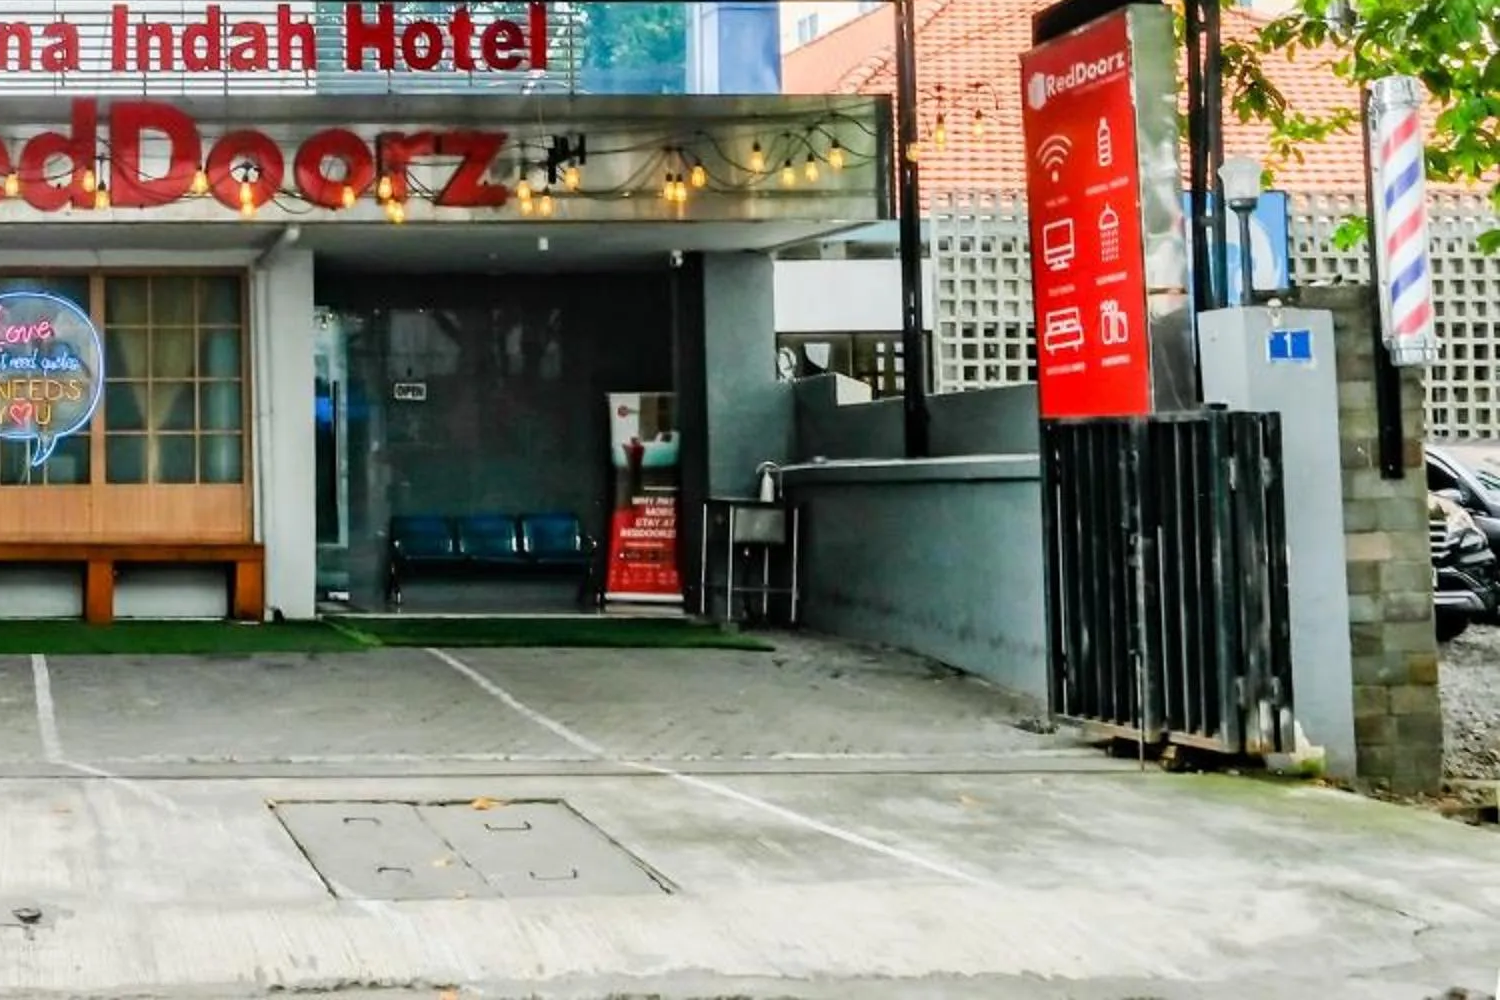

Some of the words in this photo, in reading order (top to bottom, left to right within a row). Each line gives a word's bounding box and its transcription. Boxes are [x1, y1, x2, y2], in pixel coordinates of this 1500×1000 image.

[111, 3, 316, 72] Indah
[344, 3, 549, 72] Hotel
[1045, 51, 1126, 98] RedDoorz
